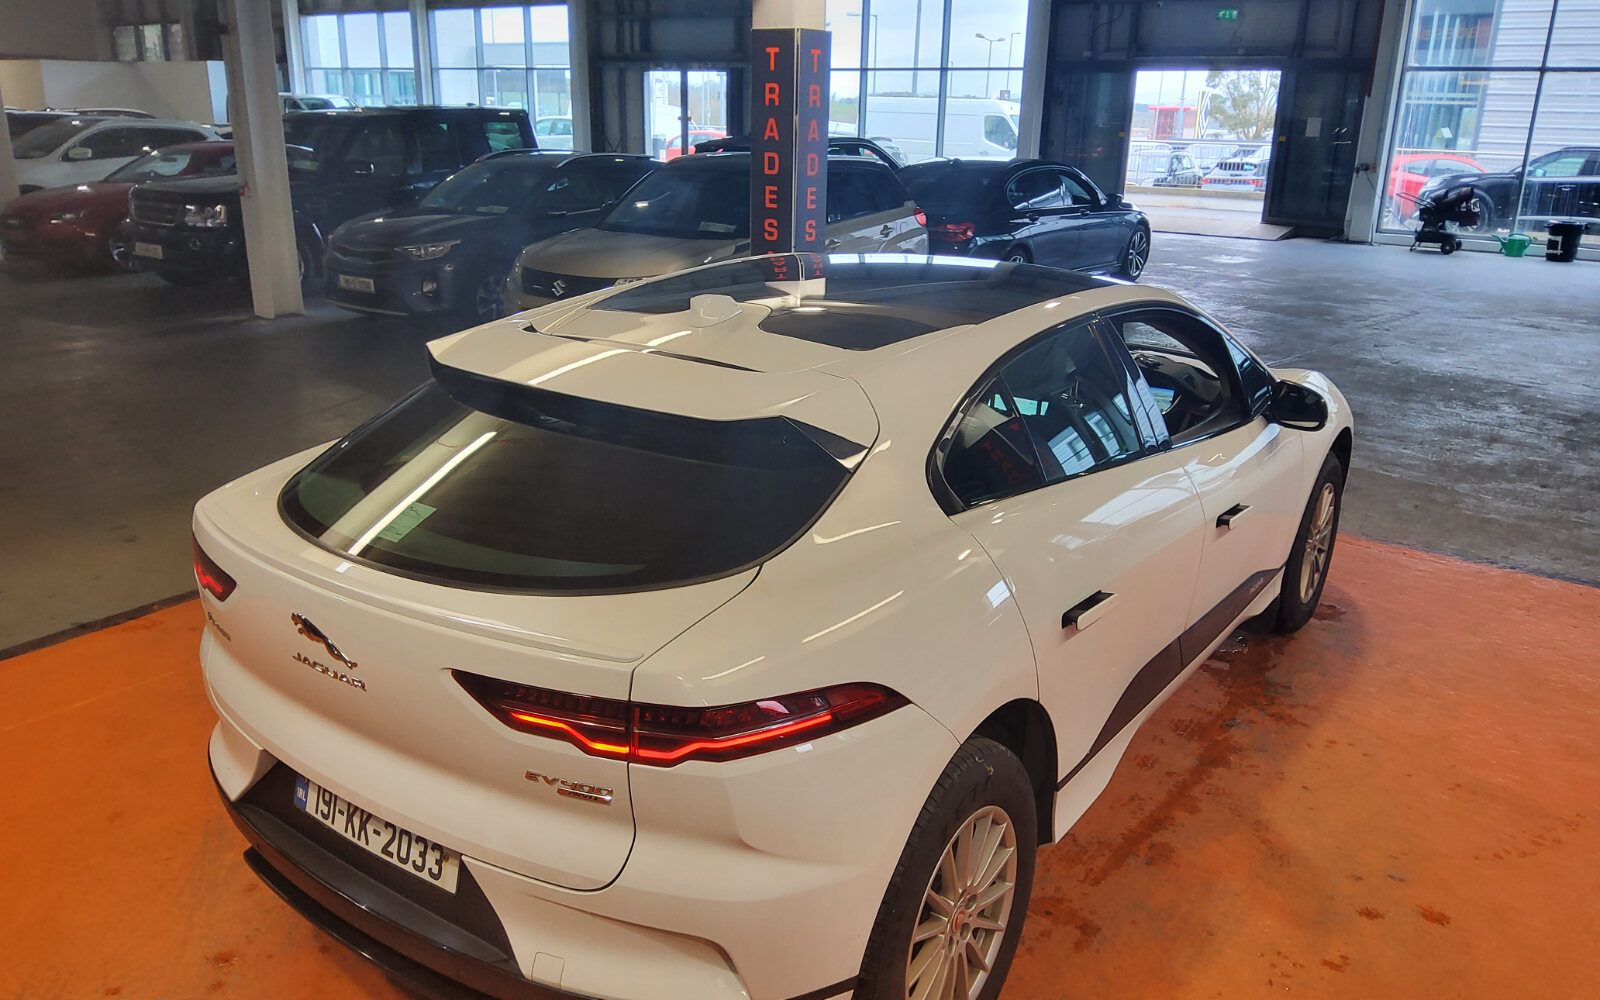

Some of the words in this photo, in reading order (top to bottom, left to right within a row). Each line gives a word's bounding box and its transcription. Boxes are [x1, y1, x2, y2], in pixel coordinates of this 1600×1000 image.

[763, 47, 780, 241] TRADES
[805, 49, 822, 242] TRADES
[292, 652, 367, 692] JAGUAR
[296, 786, 306, 802] IRL
[525, 770, 614, 797] EV400
[315, 784, 444, 881] 191-KK-2033
